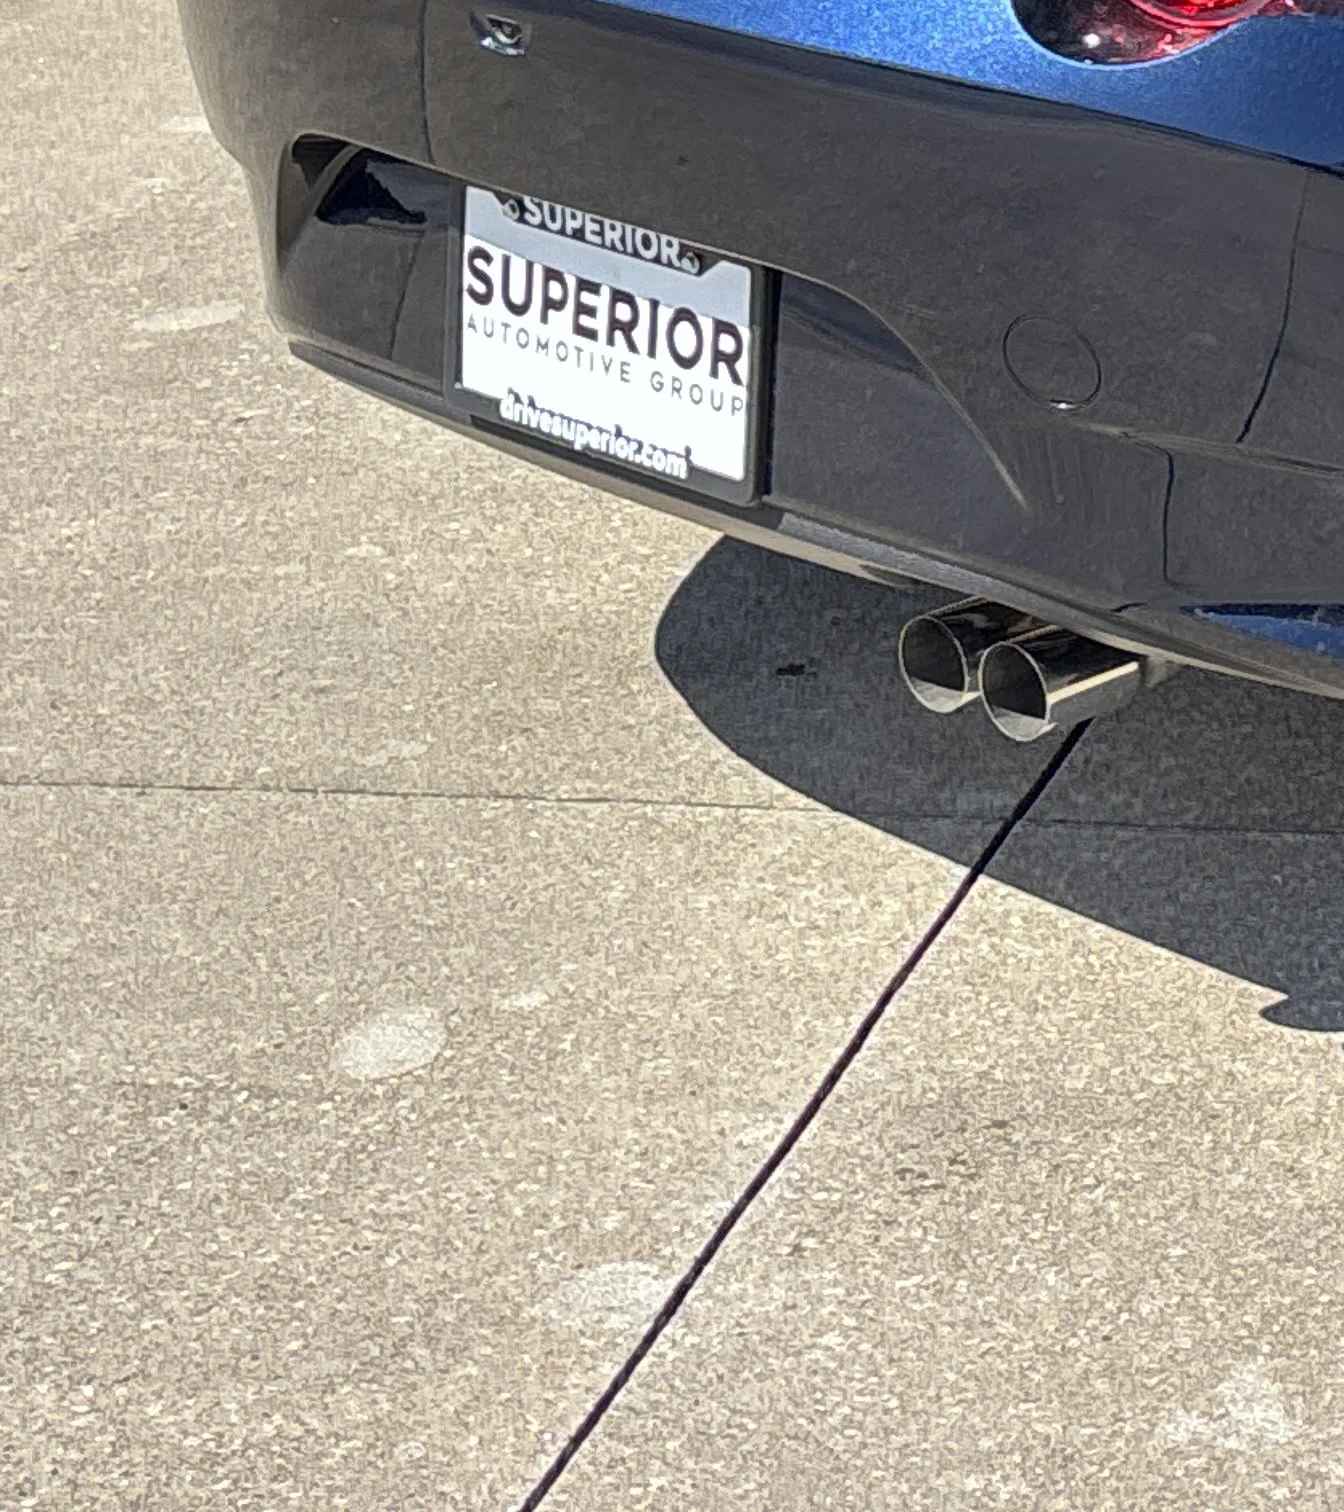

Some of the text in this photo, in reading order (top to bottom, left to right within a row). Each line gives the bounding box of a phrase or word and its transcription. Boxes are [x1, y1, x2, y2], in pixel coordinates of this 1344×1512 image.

[522, 195, 682, 267] SUPERIOR
[466, 245, 745, 388] SUPERIOR
[467, 313, 744, 417] AUTOMOTIVE GROUP
[500, 388, 690, 480] drivesuperior.com
